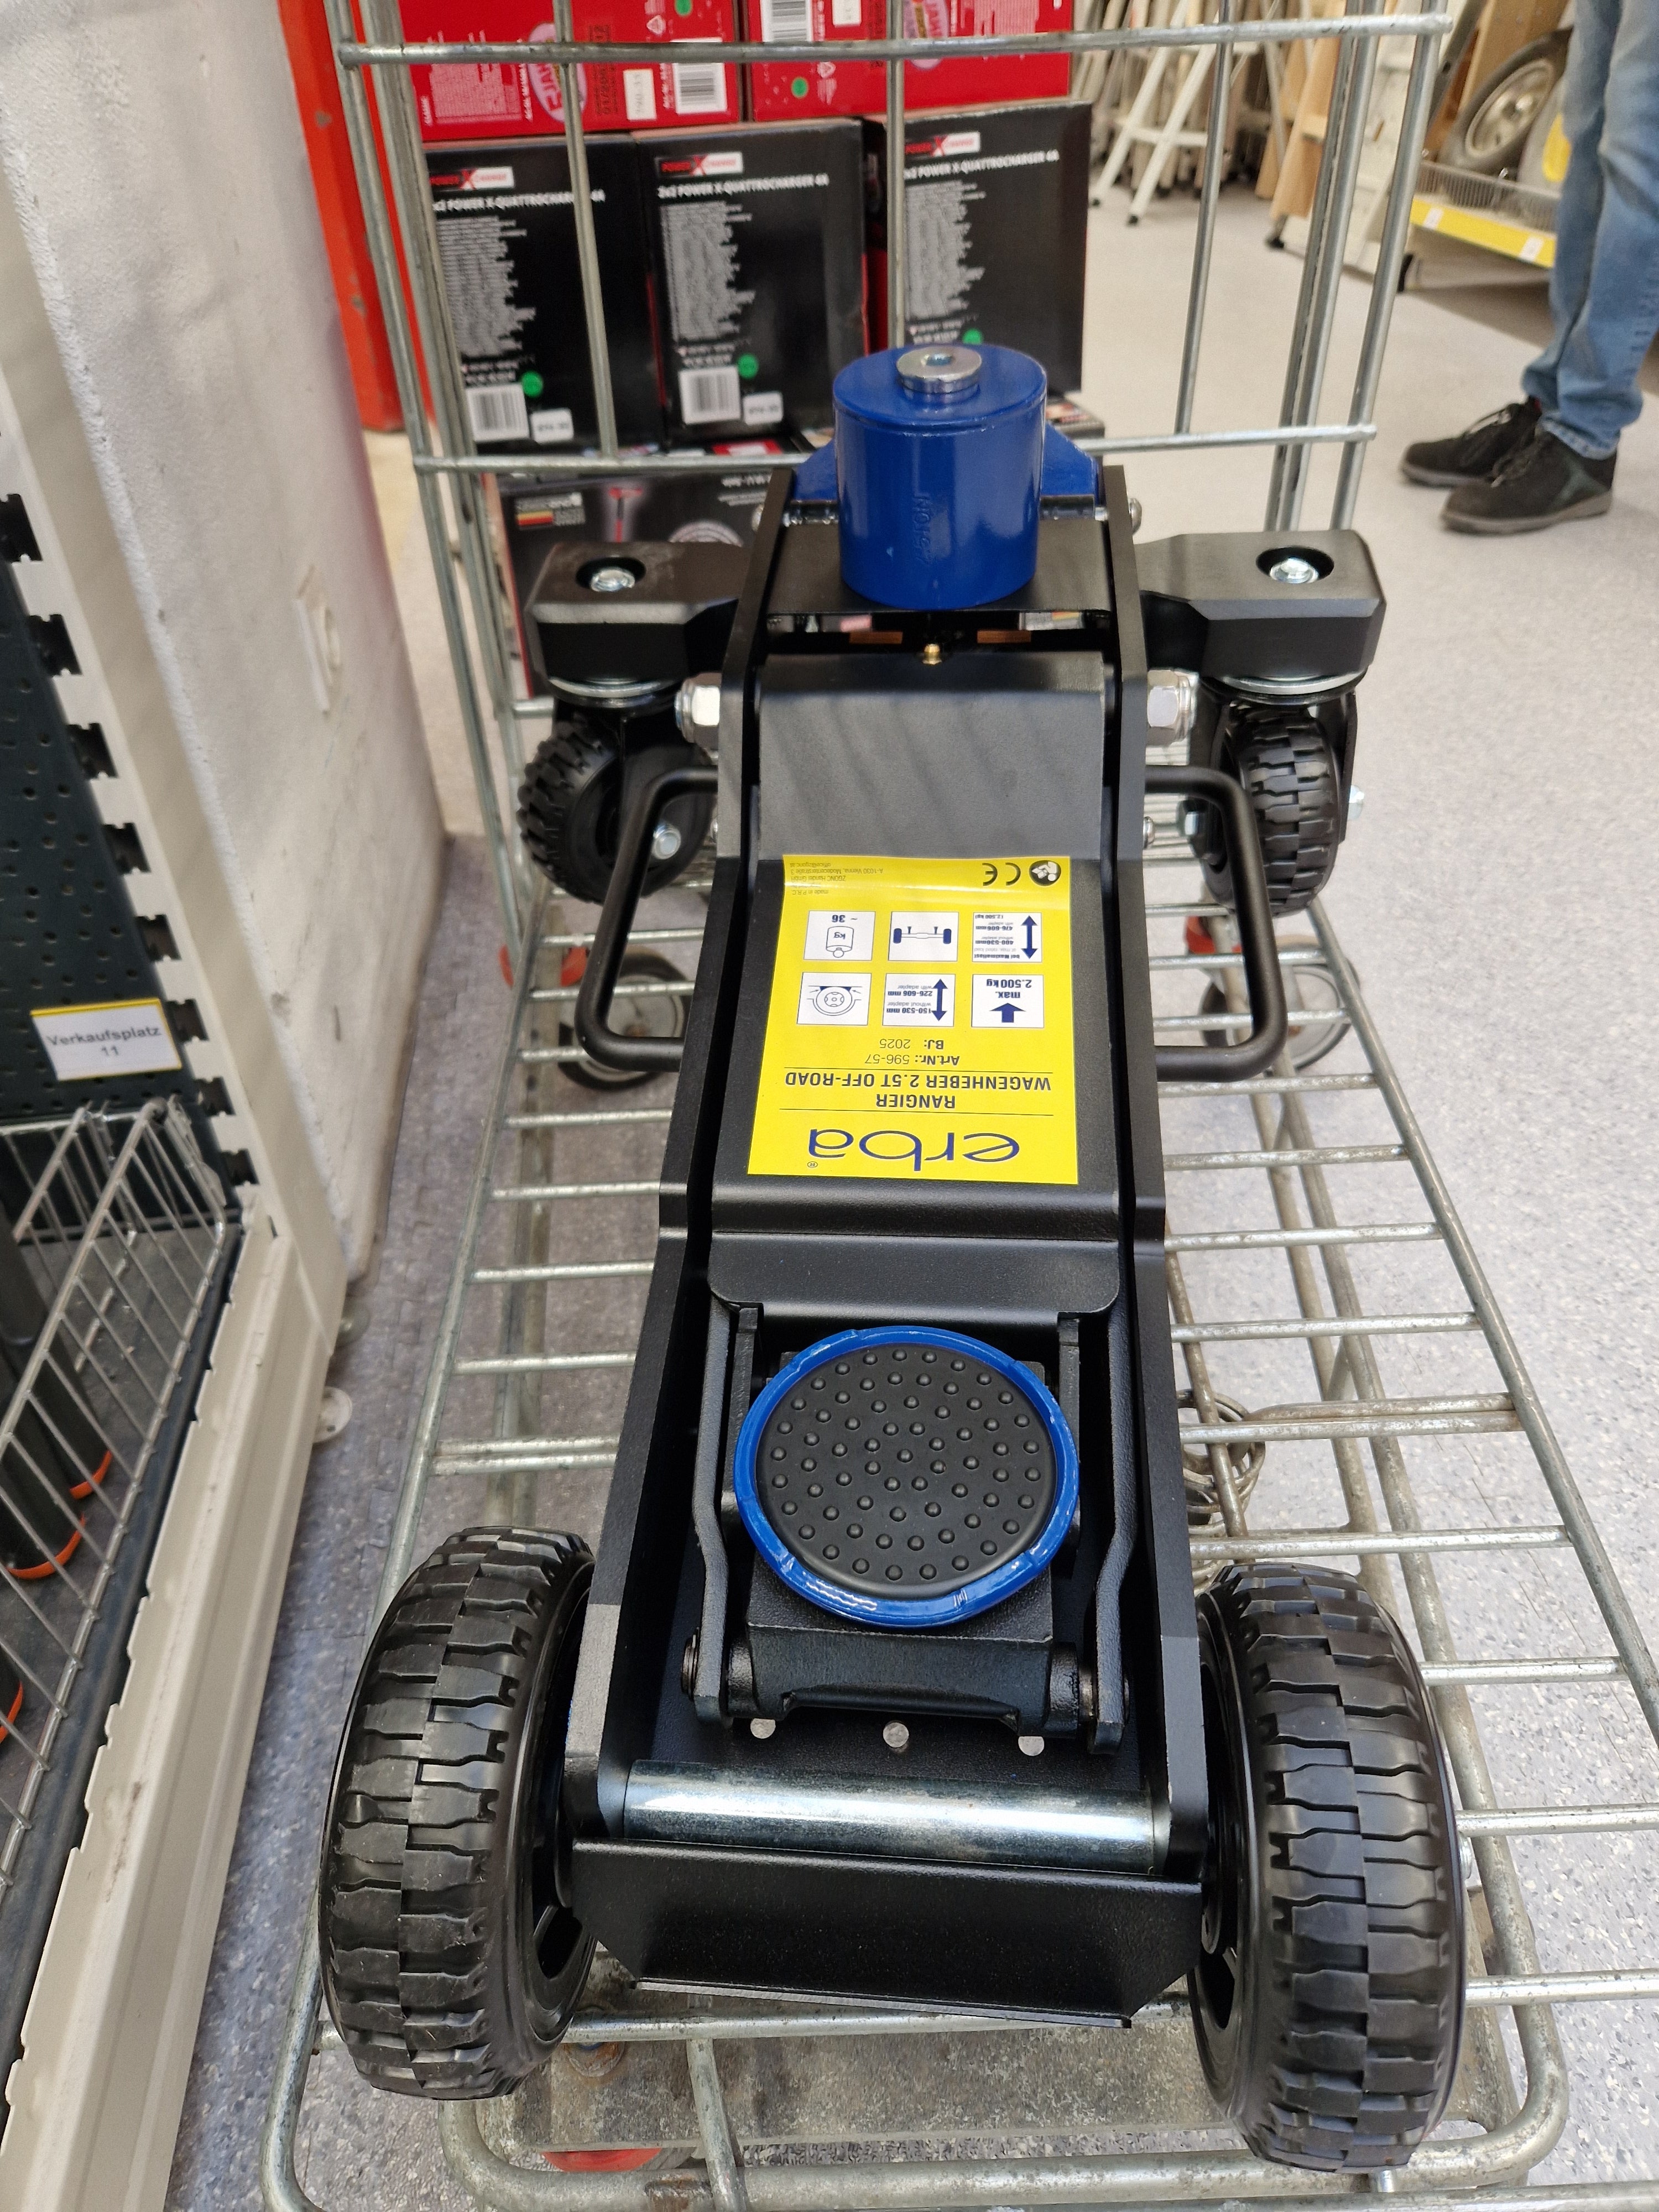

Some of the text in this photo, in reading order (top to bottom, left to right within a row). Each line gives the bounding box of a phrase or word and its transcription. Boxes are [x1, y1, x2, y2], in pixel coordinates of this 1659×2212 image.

[834, 932, 846, 940] kg
[46, 1026, 161, 1045] Verkaufsplatz
[879, 1038, 944, 1050] BJ: 2025
[101, 1046, 120, 1057] 11
[864, 1053, 961, 1066] Art.Nr.: 596-57
[785, 1071, 1051, 1091] WAGENHEBER 2.5T OFF-ROAD
[876, 1093, 956, 1109] RANGIER
